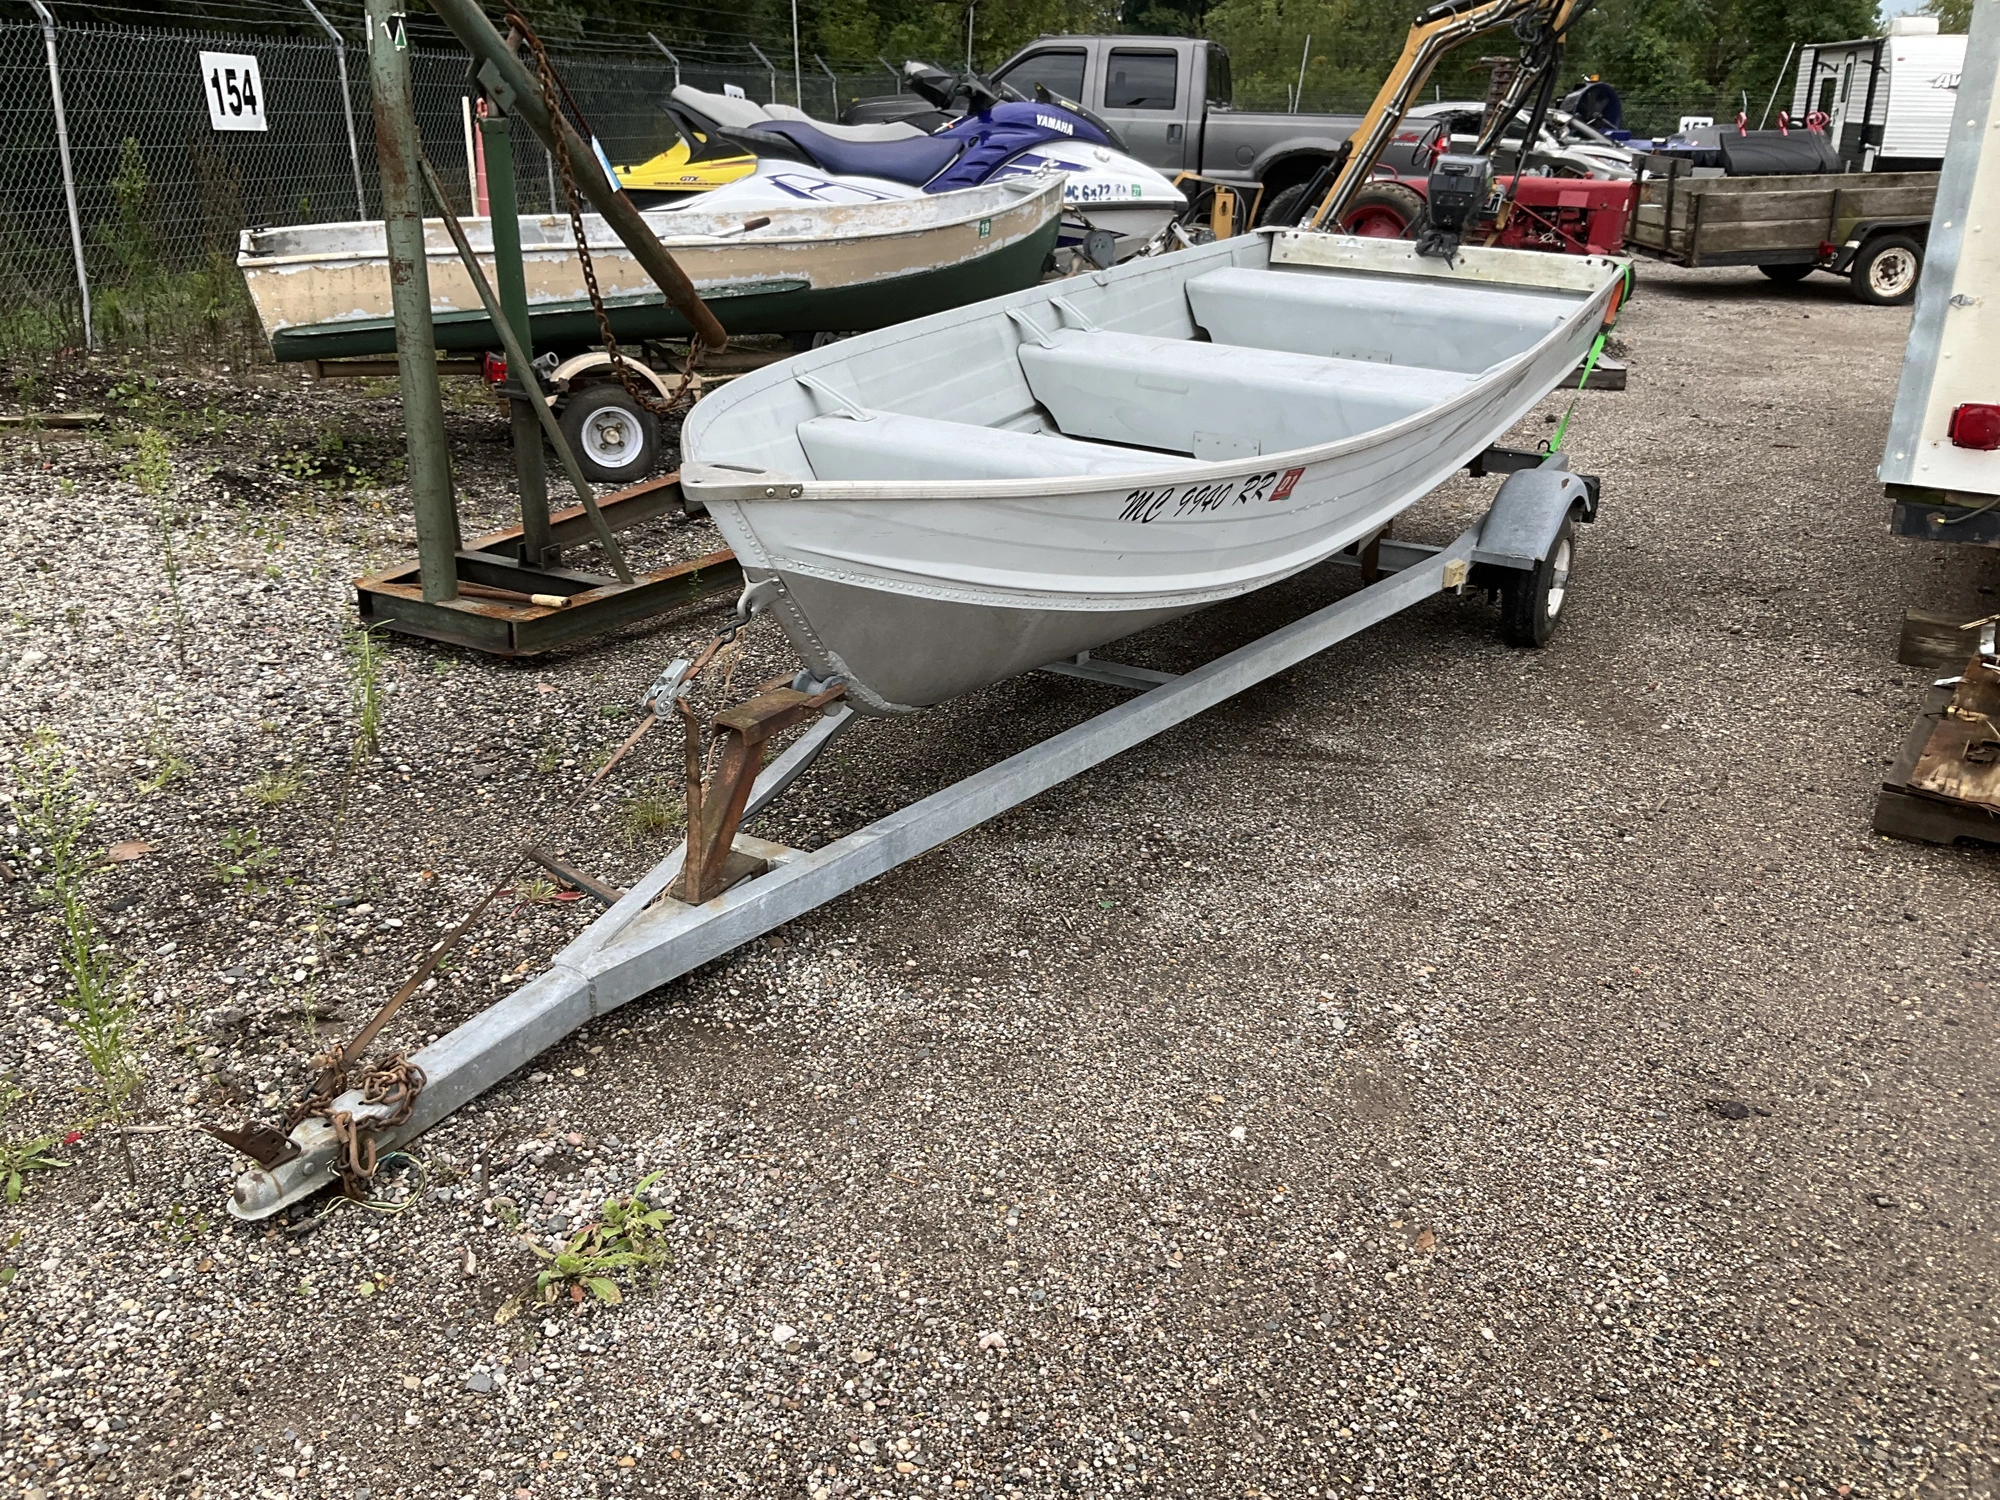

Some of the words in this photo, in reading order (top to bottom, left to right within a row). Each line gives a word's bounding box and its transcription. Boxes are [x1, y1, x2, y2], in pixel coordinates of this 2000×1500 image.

[211, 68, 257, 116] 154
[1036, 114, 1074, 136] YAMAHA
[1118, 487, 1175, 524] MC
[1173, 483, 1234, 517] 9940
[1231, 471, 1278, 507] RR
[1277, 474, 1299, 492] 01
